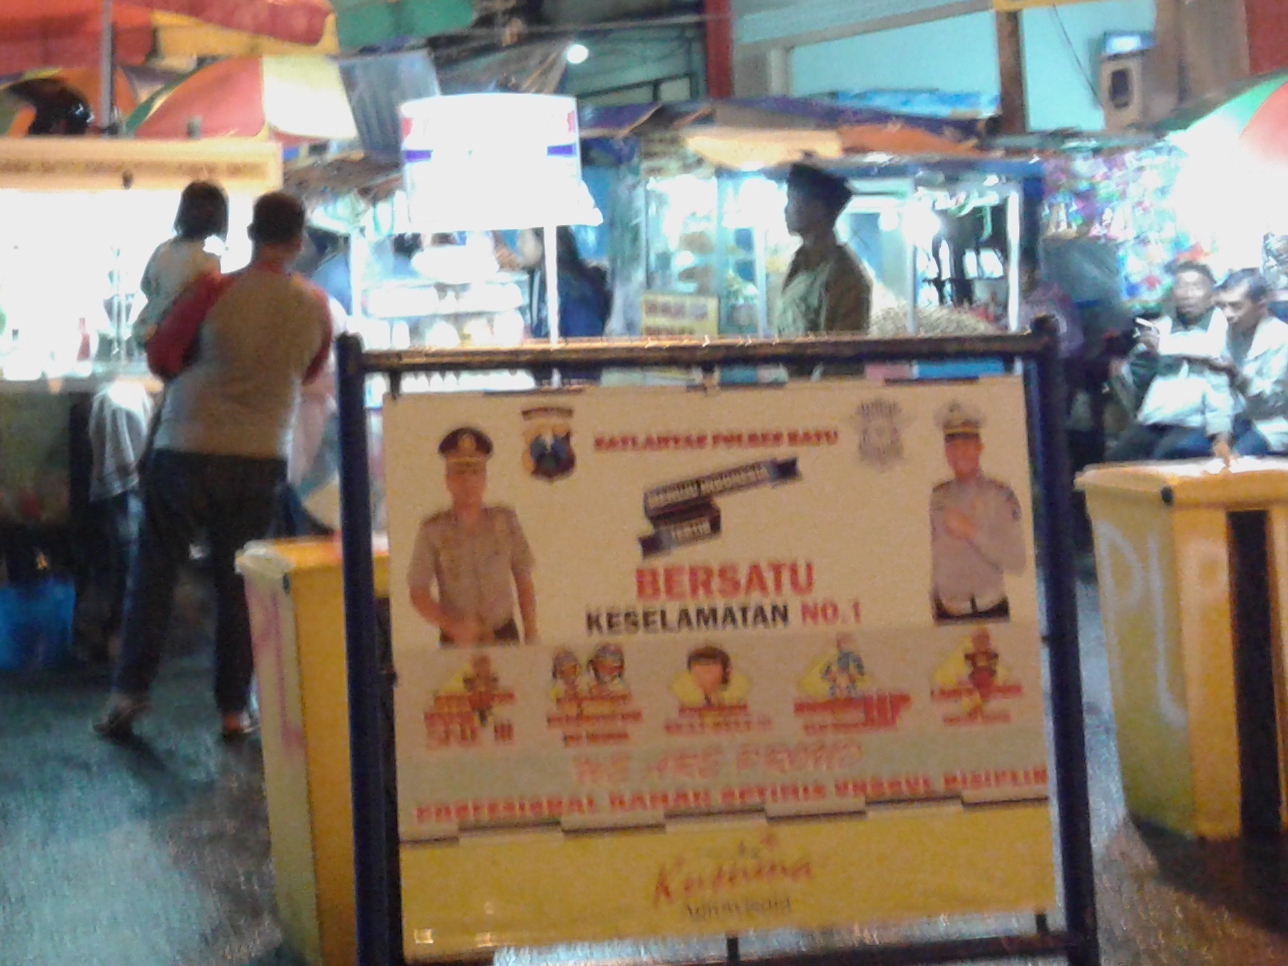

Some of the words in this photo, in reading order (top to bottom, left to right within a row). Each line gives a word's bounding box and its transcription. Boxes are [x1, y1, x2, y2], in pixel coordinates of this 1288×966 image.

[635, 560, 814, 602] BERSATU
[585, 603, 790, 636] KESELAMATAN
[800, 599, 861, 626] NO.1
